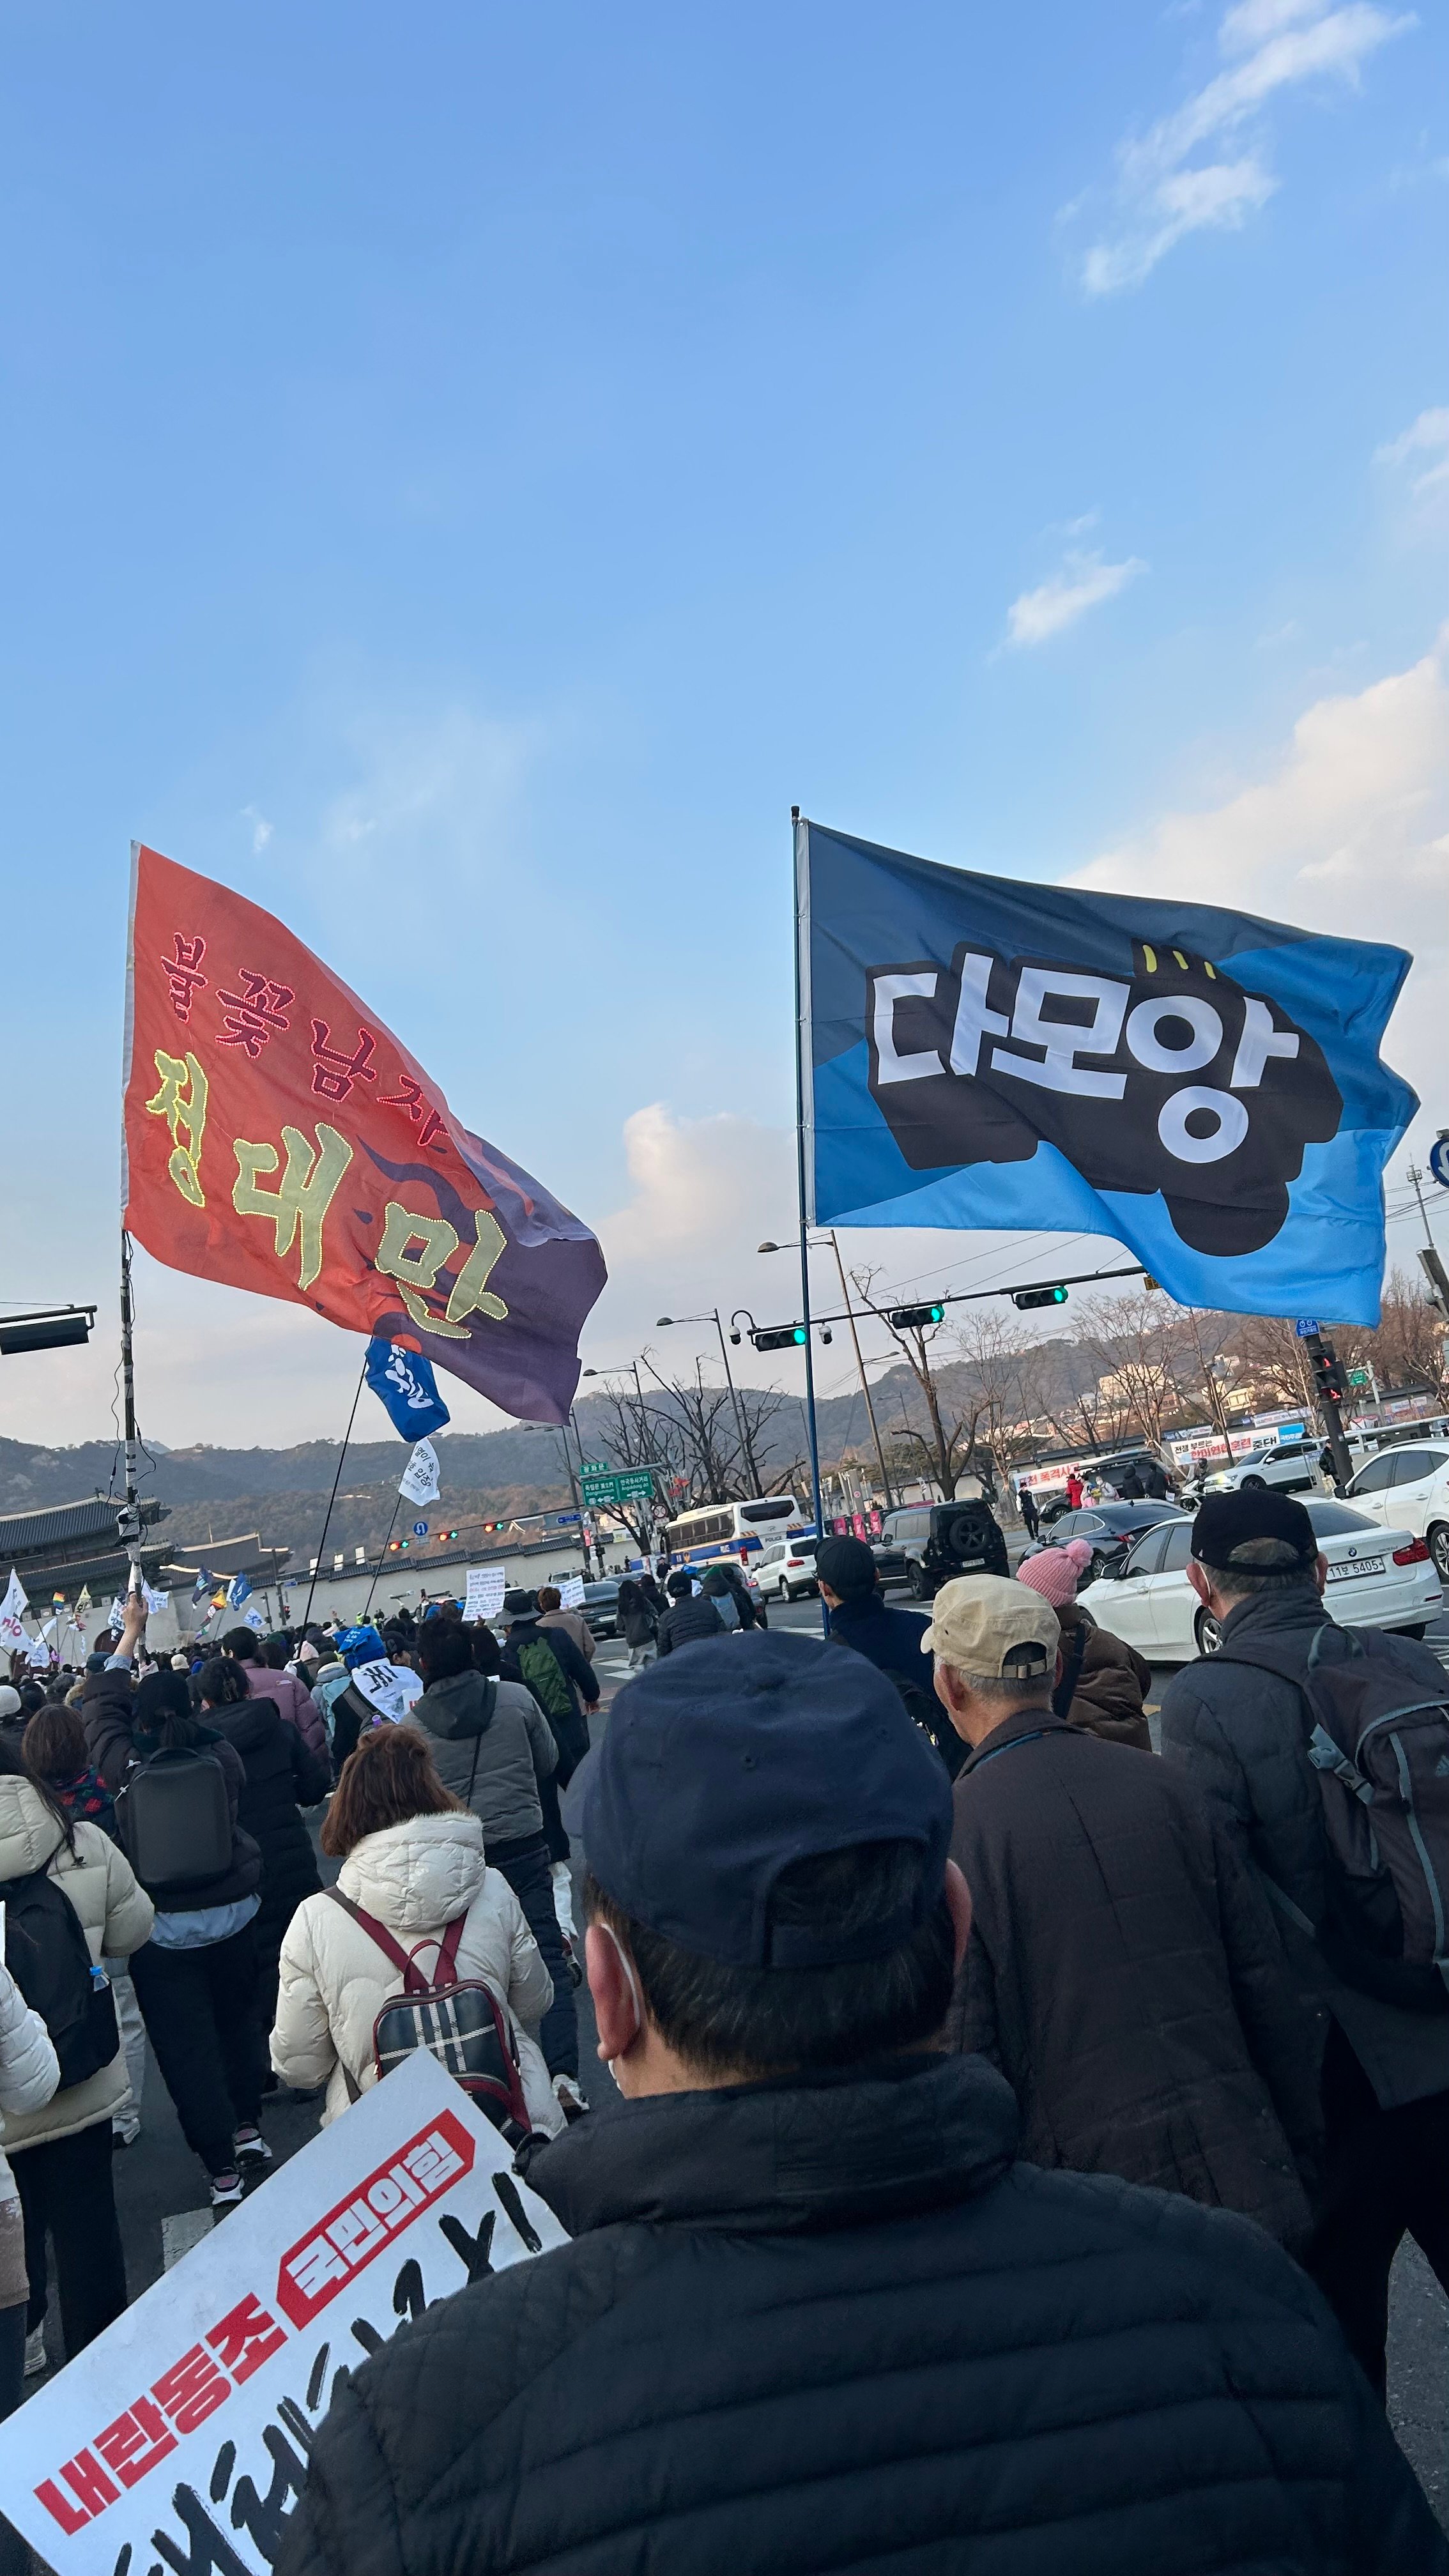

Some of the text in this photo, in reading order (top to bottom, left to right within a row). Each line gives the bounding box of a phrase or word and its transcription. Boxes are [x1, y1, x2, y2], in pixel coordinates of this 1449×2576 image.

[873, 953, 1300, 1163] 다모앙
[144, 1048, 509, 1339] 정대만
[1175, 1439, 1213, 1454] 전쟁 부르는
[1329, 1560, 1379, 1578] 11보 5405
[285, 2131, 464, 2300] 국민의힘
[33, 2292, 289, 2536] 내란동조
